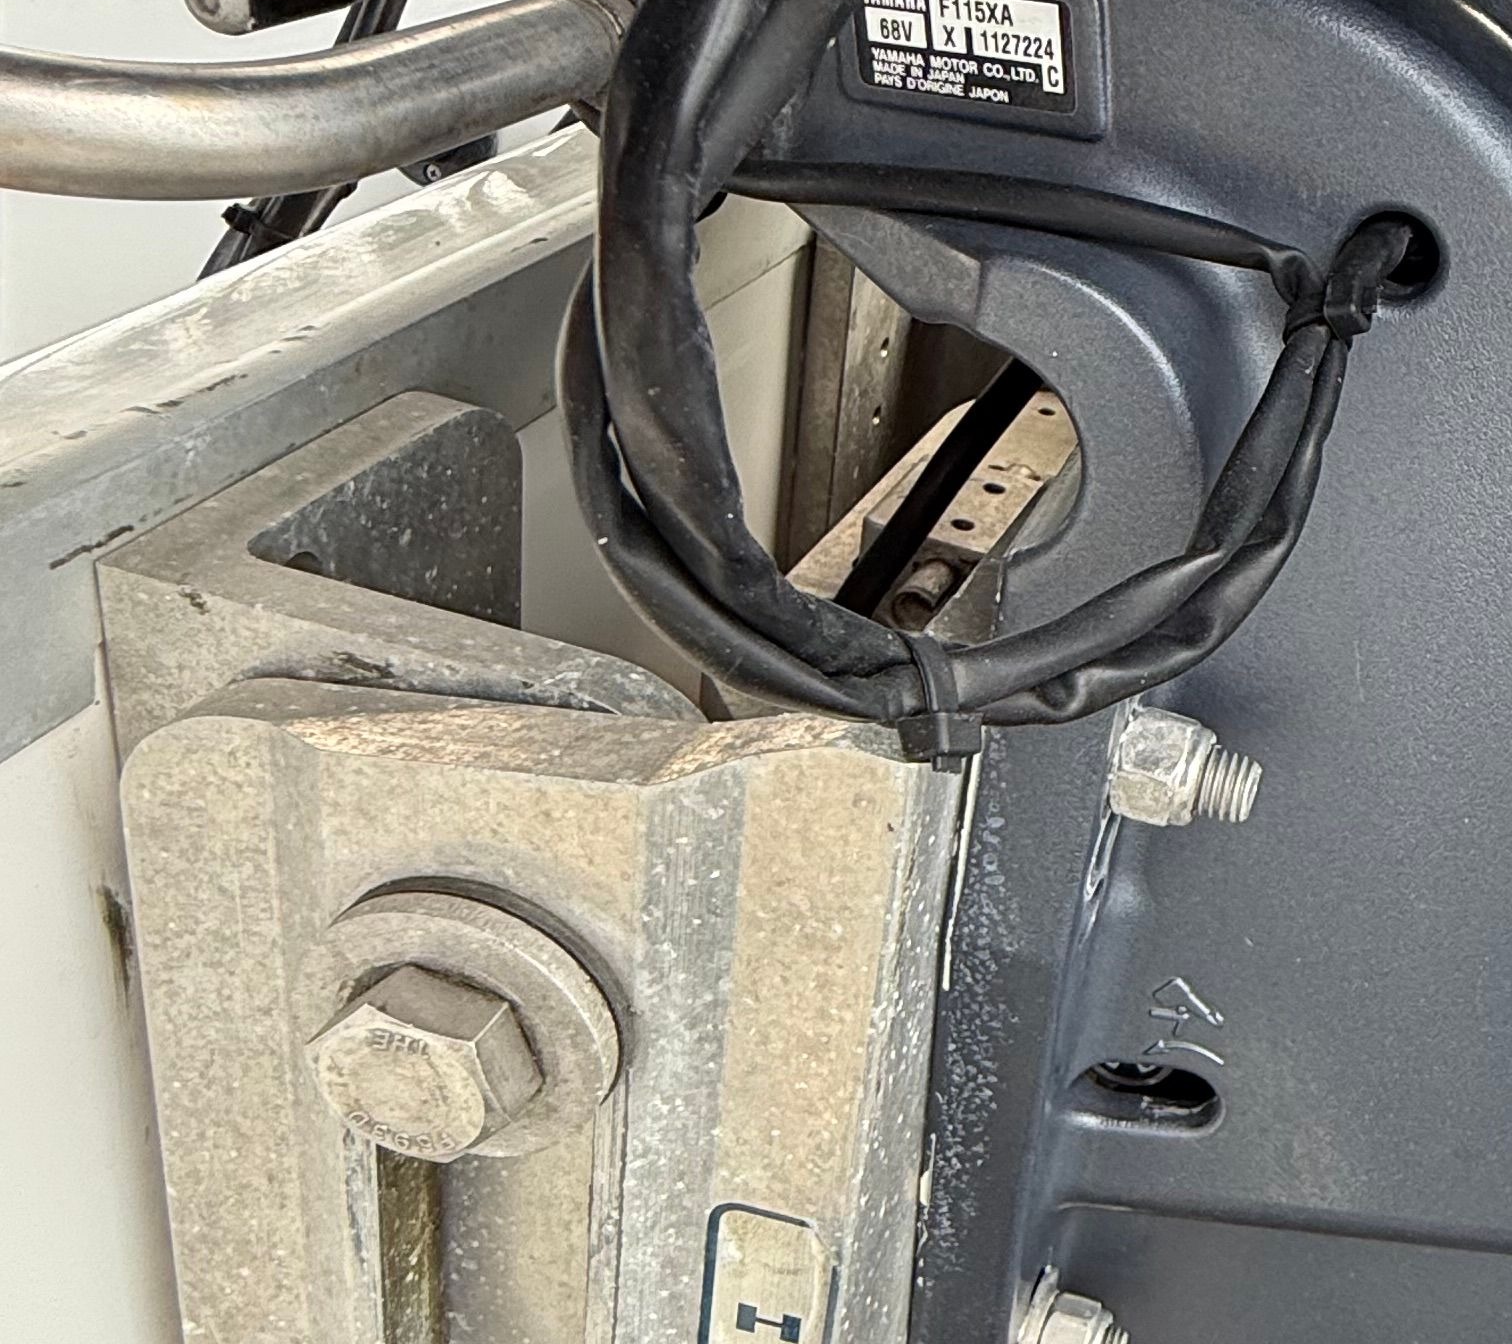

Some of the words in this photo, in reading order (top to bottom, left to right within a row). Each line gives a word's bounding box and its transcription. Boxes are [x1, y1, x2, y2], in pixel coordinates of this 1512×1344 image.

[879, 18, 913, 43] 68V
[943, 25, 956, 48] X
[980, 29, 1055, 61] 1127224
[871, 47, 925, 67] YAMAHA
[929, 54, 978, 75] MOTOR
[872, 61, 907, 76] MADE
[910, 65, 924, 78] IN
[927, 69, 965, 84] JAPAN
[874, 73, 903, 89] PAYS
[969, 85, 1010, 104] JAPON
[1047, 65, 1059, 88] C
